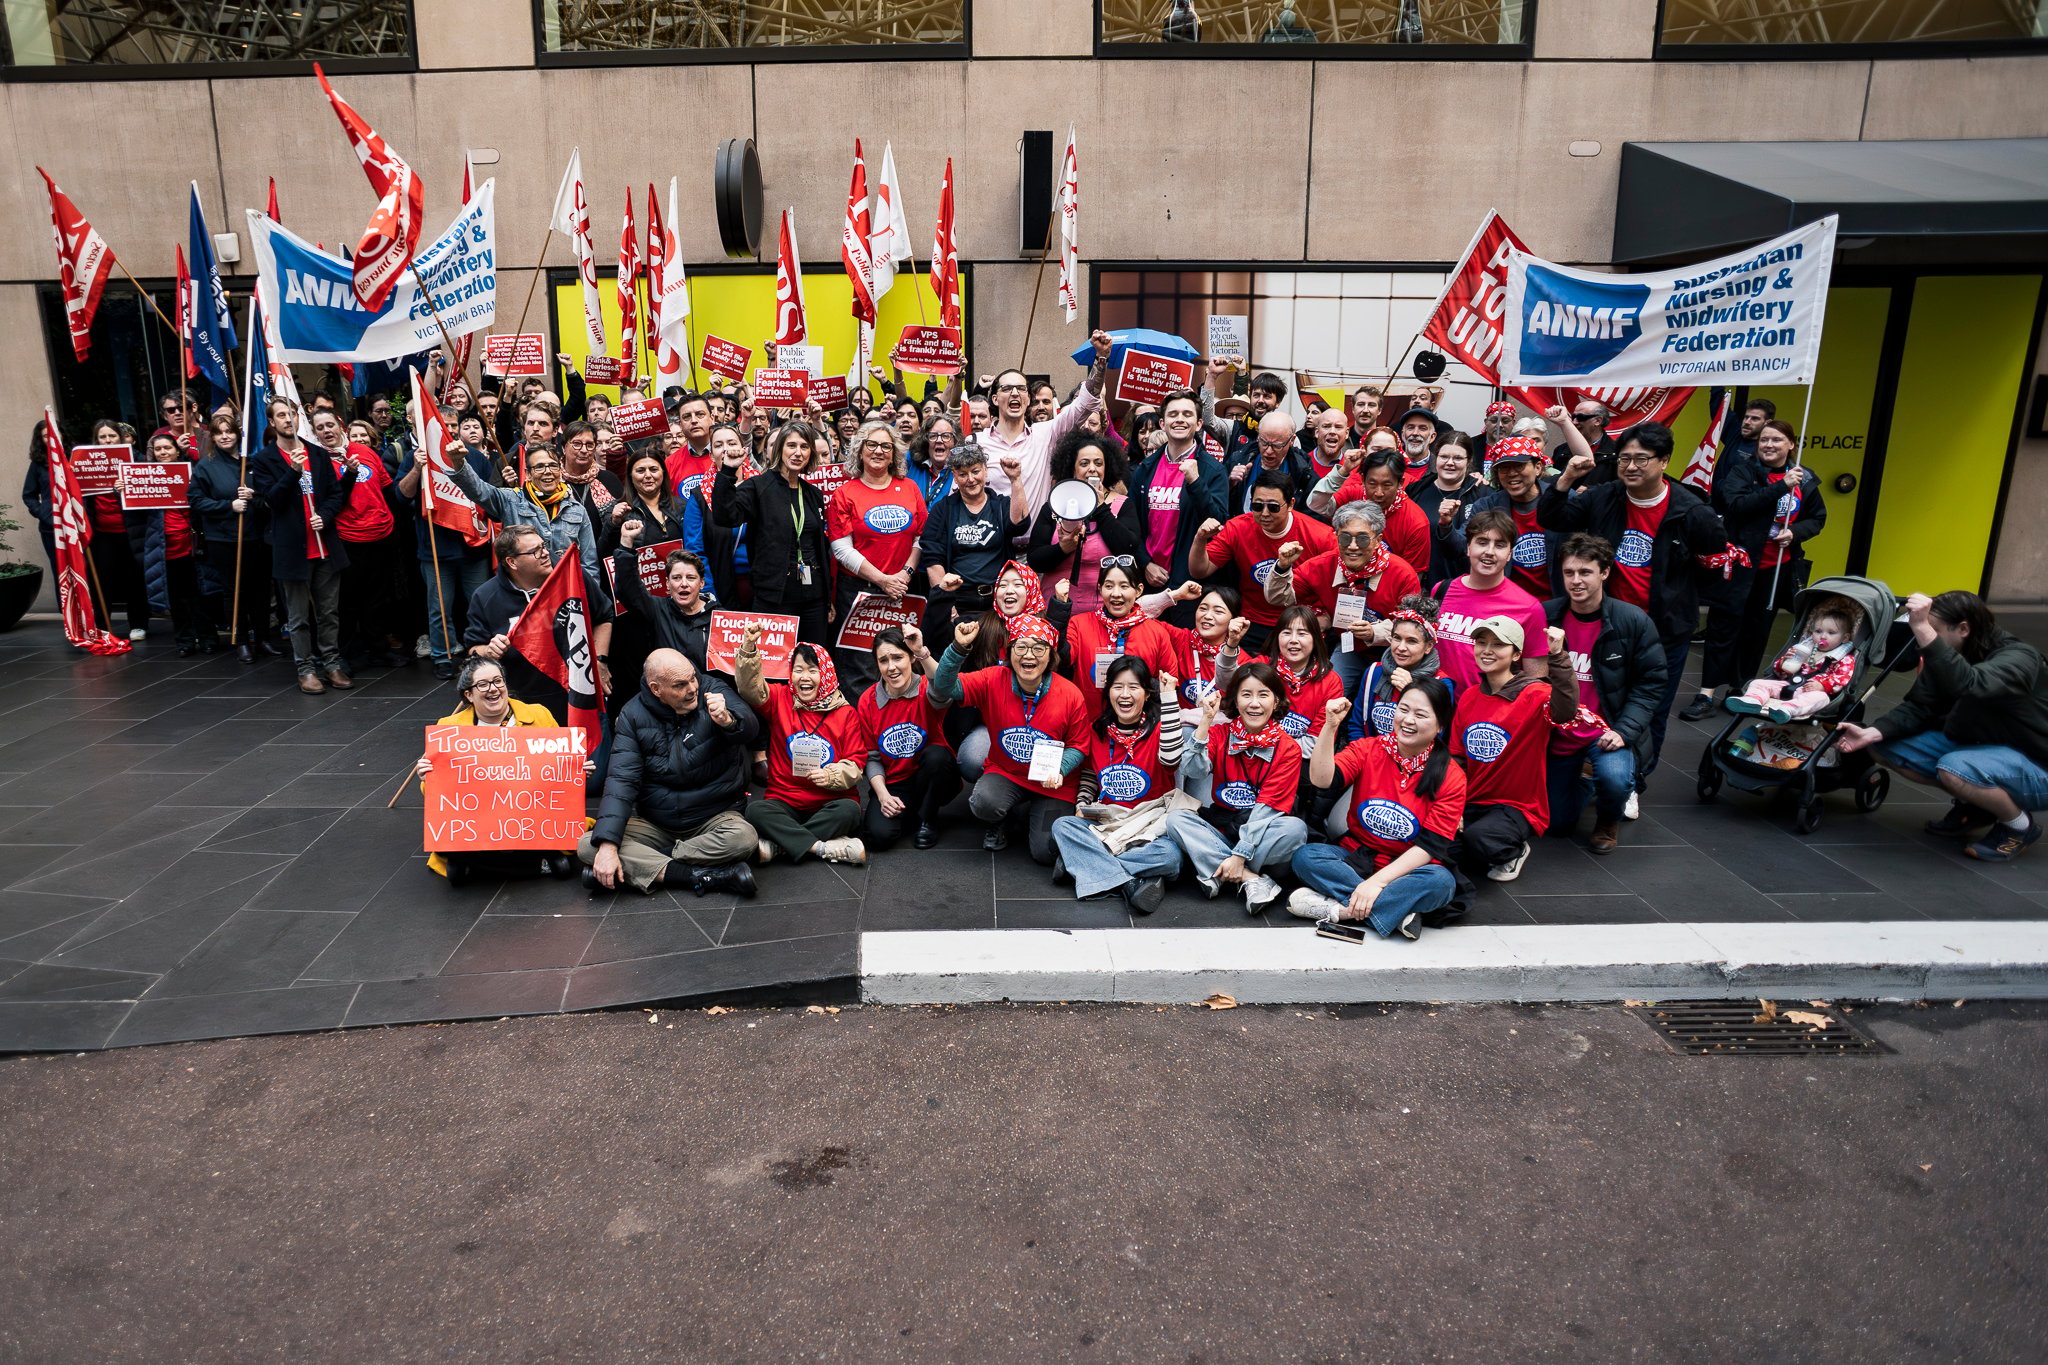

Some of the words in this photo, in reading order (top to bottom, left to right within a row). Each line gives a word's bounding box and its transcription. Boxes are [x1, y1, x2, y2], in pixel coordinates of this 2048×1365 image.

[472, 224, 487, 243] &
[850, 247, 872, 280] Public
[1672, 242, 1805, 292] Australian
[285, 267, 370, 312] ANM
[1664, 275, 1768, 311] Nursing
[1772, 267, 1794, 290] &
[408, 273, 496, 321] Federatio
[1527, 300, 1638, 340] ANMF
[1665, 300, 1794, 329] Midwifery
[414, 309, 469, 340] VICTORIAN
[1210, 317, 1232, 326] Public
[588, 317, 605, 345] Union
[921, 330, 938, 339] VPS
[1209, 333, 1221, 341] job
[198, 331, 209, 345] By
[903, 338, 922, 346] rank
[924, 339, 939, 347] and
[941, 340, 954, 348] file
[1210, 339, 1223, 347] will
[1660, 327, 1796, 353] Federation
[708, 344, 722, 355] rank
[723, 349, 733, 358] and
[733, 352, 744, 361] file
[721, 342, 735, 351] VPS
[779, 346, 806, 357] Public
[899, 344, 907, 352] is
[909, 345, 936, 355] frankly
[939, 347, 957, 356] riled
[1211, 347, 1240, 355] Victoria.
[711, 351, 730, 363] frankly
[730, 357, 745, 368] riled
[779, 356, 806, 365] sector
[1150, 360, 1168, 372] VPS
[1659, 360, 1727, 375] VICTORIAN
[1732, 357, 1791, 372] BRANCH
[586, 369, 611, 377] Furious
[756, 369, 791, 379] Frank&
[1132, 365, 1150, 376] rank
[1152, 370, 1167, 380] and
[1169, 372, 1183, 383] file
[755, 378, 804, 388] Fearless&
[814, 380, 828, 388] VPS
[1127, 371, 1135, 380] is
[1136, 373, 1164, 386] frankly
[1165, 381, 1184, 391] riled
[755, 386, 791, 397] Furious
[610, 402, 646, 417] Frank&
[612, 407, 661, 426] Fearless&
[614, 420, 651, 434] Furious
[1810, 435, 1864, 449] PLACE
[88, 451, 107, 459] VPS
[74, 458, 93, 466] rank
[82, 465, 108, 473] frankly
[122, 465, 167, 476] Frank&
[123, 474, 185, 485] Fearless&
[125, 484, 170, 494] Furious
[432, 476, 468, 500] ublic
[871, 509, 907, 519] NURSES
[872, 518, 907, 529] MIDWIVES
[955, 533, 983, 542] UNION
[852, 606, 919, 625] Fearless&
[765, 633, 785, 646] All
[428, 726, 517, 754] Touch
[526, 727, 587, 755] wonk
[1469, 730, 1503, 741] NURSES
[1468, 739, 1504, 748] MIDWIVES
[1468, 745, 1503, 757] CARERS
[450, 755, 531, 784] Touch
[541, 755, 587, 786] all!
[1106, 786, 1142, 796] CARERS
[439, 792, 479, 812] NO
[491, 790, 566, 811] MORE
[1365, 812, 1410, 833] MIDWIVES
[1368, 806, 1410, 827] NURSES
[427, 819, 478, 842] VPS
[490, 818, 535, 842] JOB
[541, 819, 585, 840] CUTS
[1365, 818, 1407, 838] CARERS
